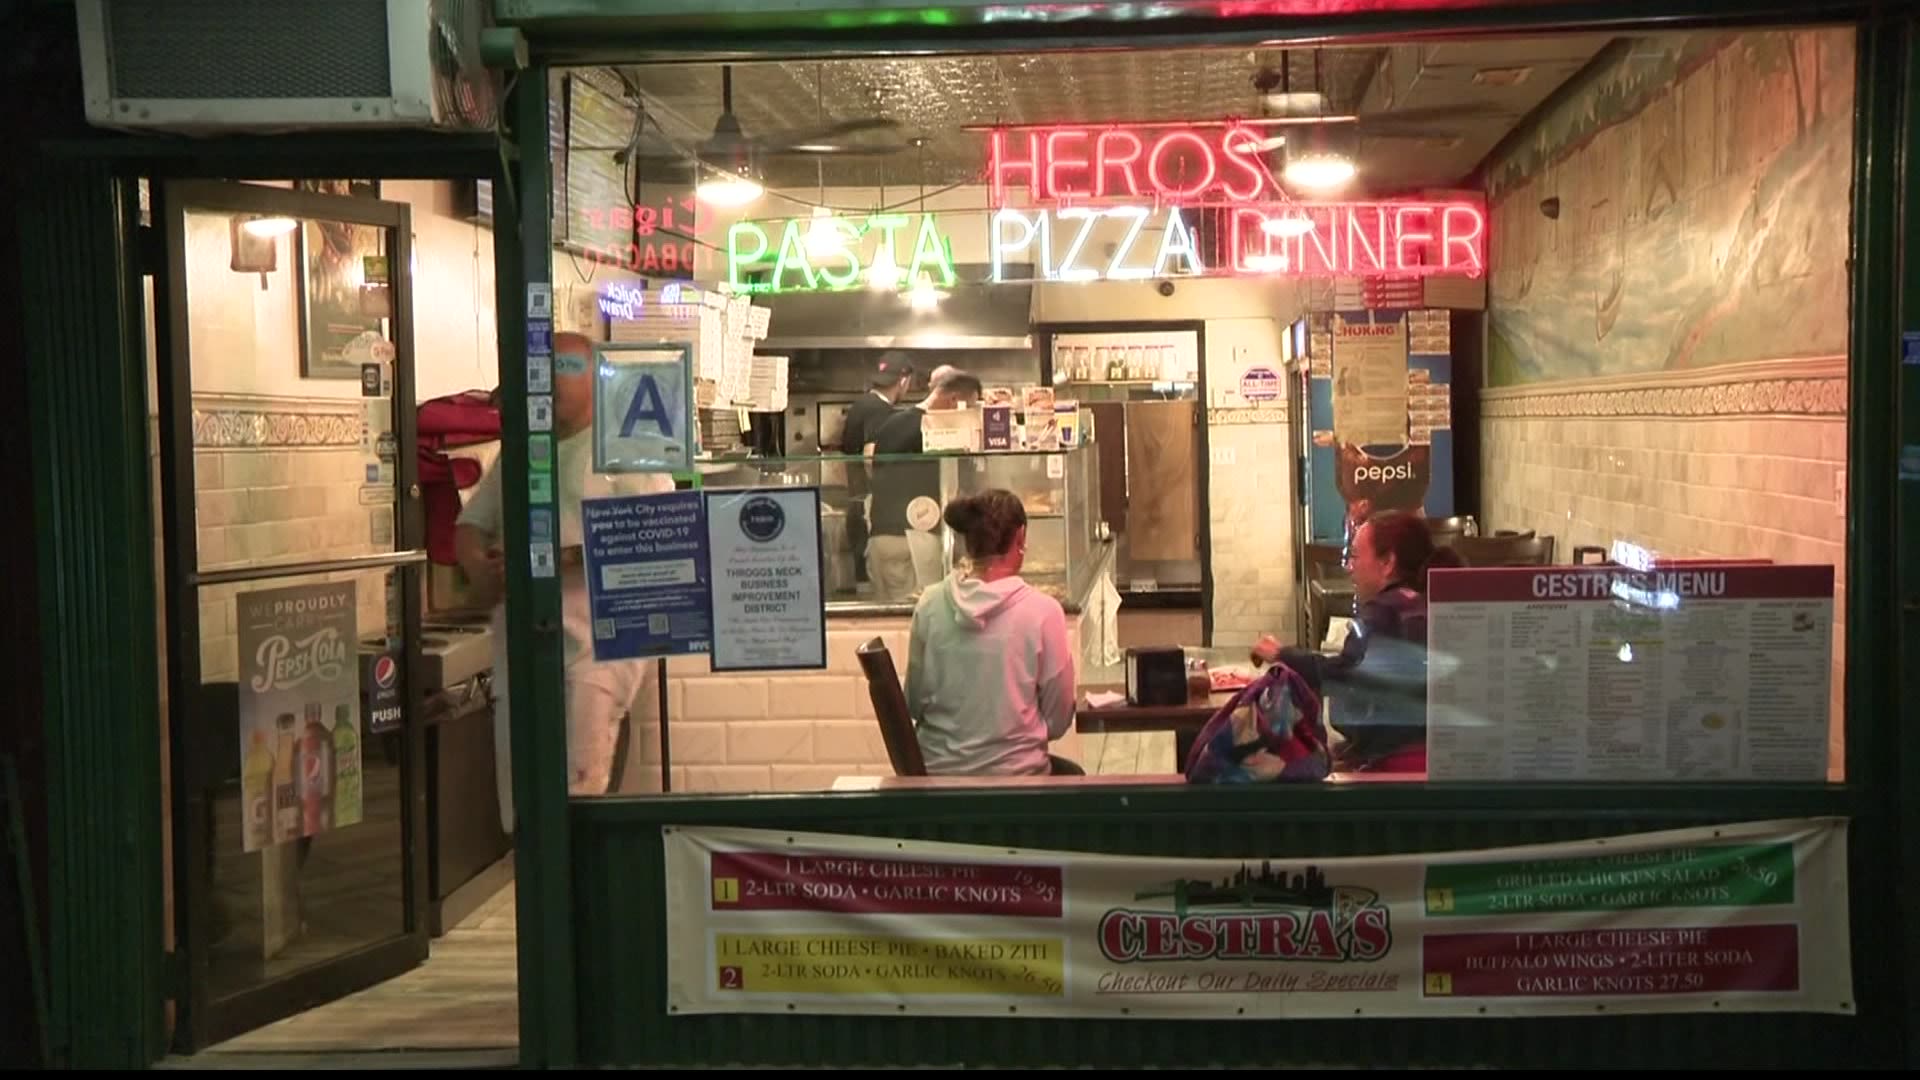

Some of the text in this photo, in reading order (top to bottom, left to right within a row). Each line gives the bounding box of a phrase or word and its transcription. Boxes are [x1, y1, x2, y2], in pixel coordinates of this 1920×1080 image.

[991, 128, 1263, 200] HEROS
[993, 207, 1200, 281] PIZZA
[1231, 206, 1483, 273] DINNER
[727, 213, 955, 291] PASTA
[618, 374, 674, 438] A
[987, 437, 1008, 448] VISA
[1354, 462, 1412, 484] pepsi
[635, 504, 656, 516] City
[591, 521, 613, 533] you
[638, 526, 689, 540] COVID-19
[726, 566, 802, 578] THROGGS NECK
[741, 579, 788, 590] BUSINESS
[1656, 572, 1726, 597] MENU
[274, 594, 346, 615] PROUDLY
[731, 590, 801, 602] IMPROVEMENT
[744, 602, 787, 614] DISTRICT
[372, 707, 401, 724] PUSH
[799, 862, 863, 877] LARGE
[1497, 870, 1572, 888] GRILLED
[1576, 867, 1658, 886] CHICKEN
[721, 882, 730, 900] 1
[802, 882, 858, 899] SODA
[874, 885, 946, 901] GARLIC
[954, 886, 1022, 903] KNOTS
[1013, 869, 1057, 903] 19.95
[1527, 934, 1593, 950] LARGE
[1597, 931, 1672, 947] CHEESE
[1677, 929, 1707, 945] PIE
[736, 941, 801, 957] LARGE
[806, 941, 883, 958] CHEESE
[887, 941, 917, 957] PIE
[935, 943, 1004, 961] BAKED
[1010, 944, 1048, 962] ZITI
[1465, 948, 1754, 970] BUFFALO WINGS 2-LITER SODA
[723, 968, 737, 989] 2
[761, 963, 807, 979] 2-LTR
[813, 965, 861, 979] SODA
[876, 966, 940, 981] GARLIC
[1098, 970, 1187, 991] Checkout
[1197, 971, 1234, 990] Our
[1243, 970, 1298, 993] Daily
[1431, 975, 1445, 993] 4
[1517, 972, 1704, 994] GARLIC KNOTS 27.50
